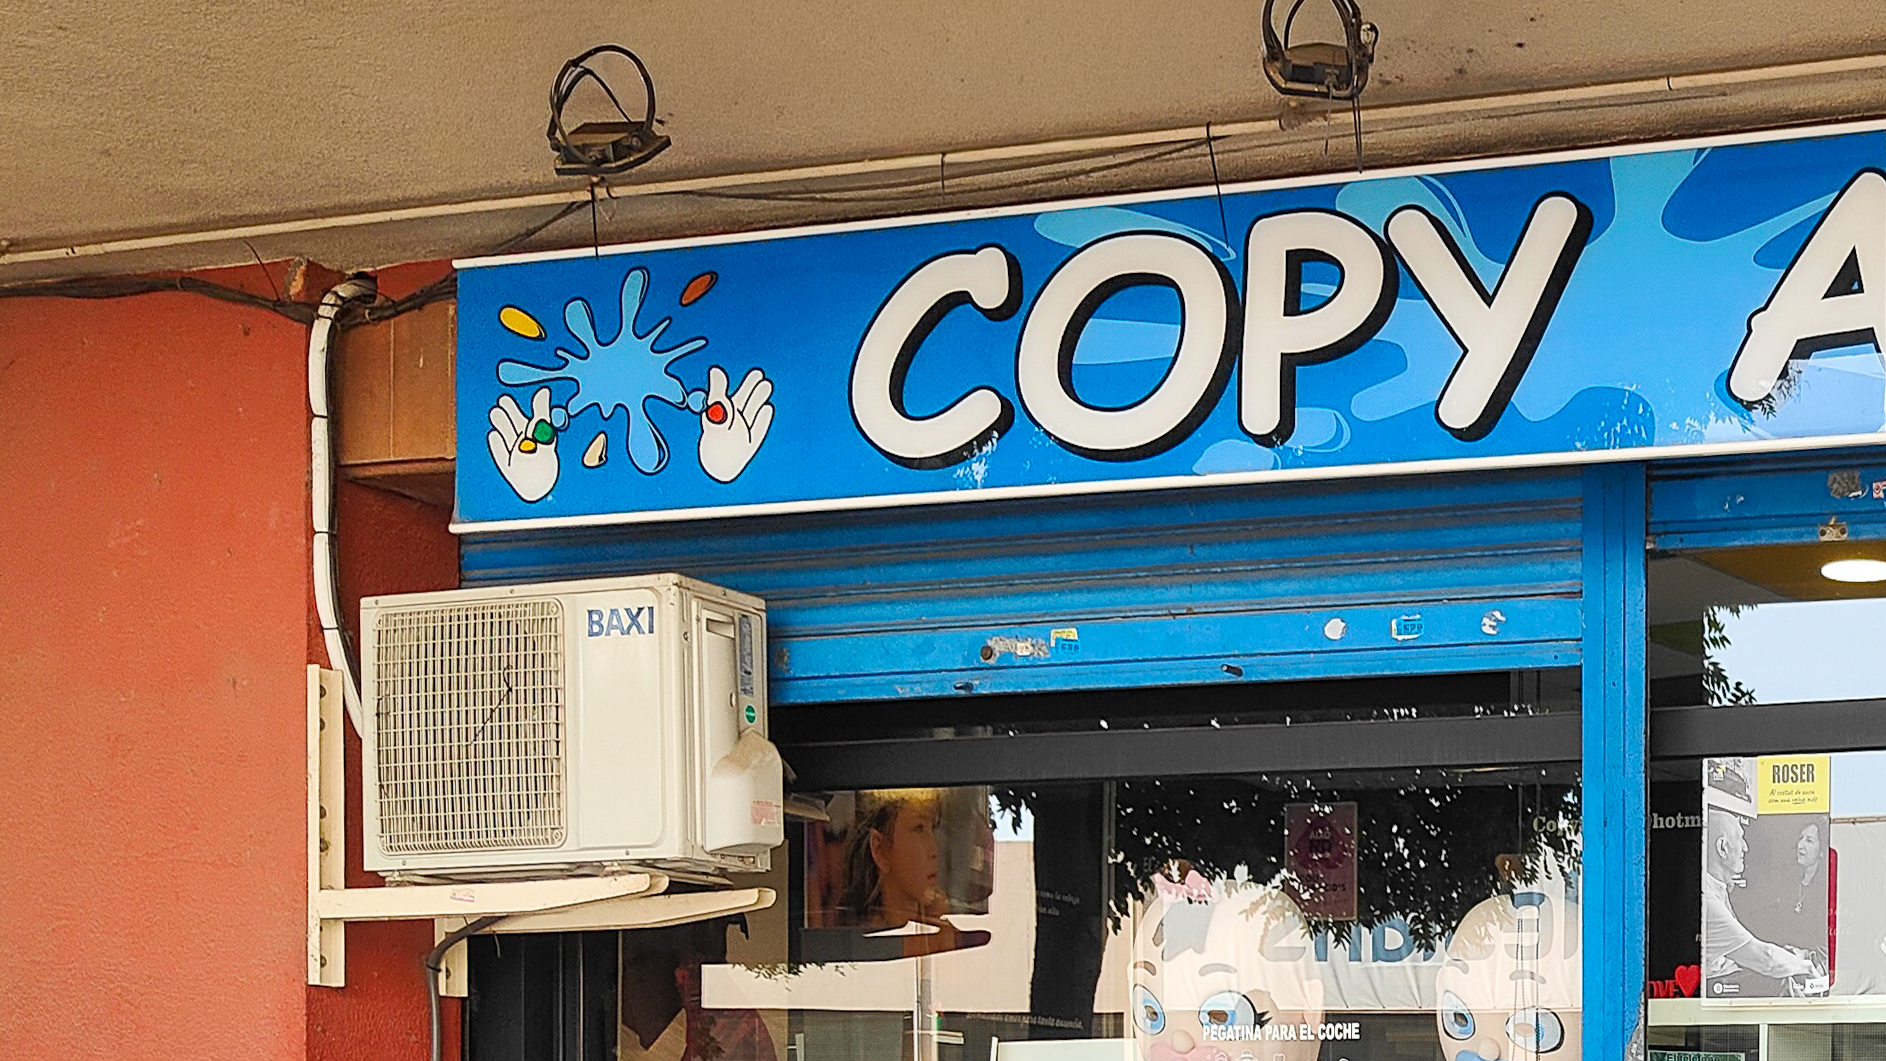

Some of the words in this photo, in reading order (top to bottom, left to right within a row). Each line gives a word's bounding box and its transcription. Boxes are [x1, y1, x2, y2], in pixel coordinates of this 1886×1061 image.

[848, 192, 1594, 467] COPY
[587, 606, 654, 637] BAXI
[1772, 763, 1815, 784] ROSER
[1203, 1025, 1262, 1041] PEGATINA
[1265, 1024, 1297, 1040] PARA
[1300, 1024, 1317, 1040] EL
[1317, 1022, 1361, 1040] COCHE
